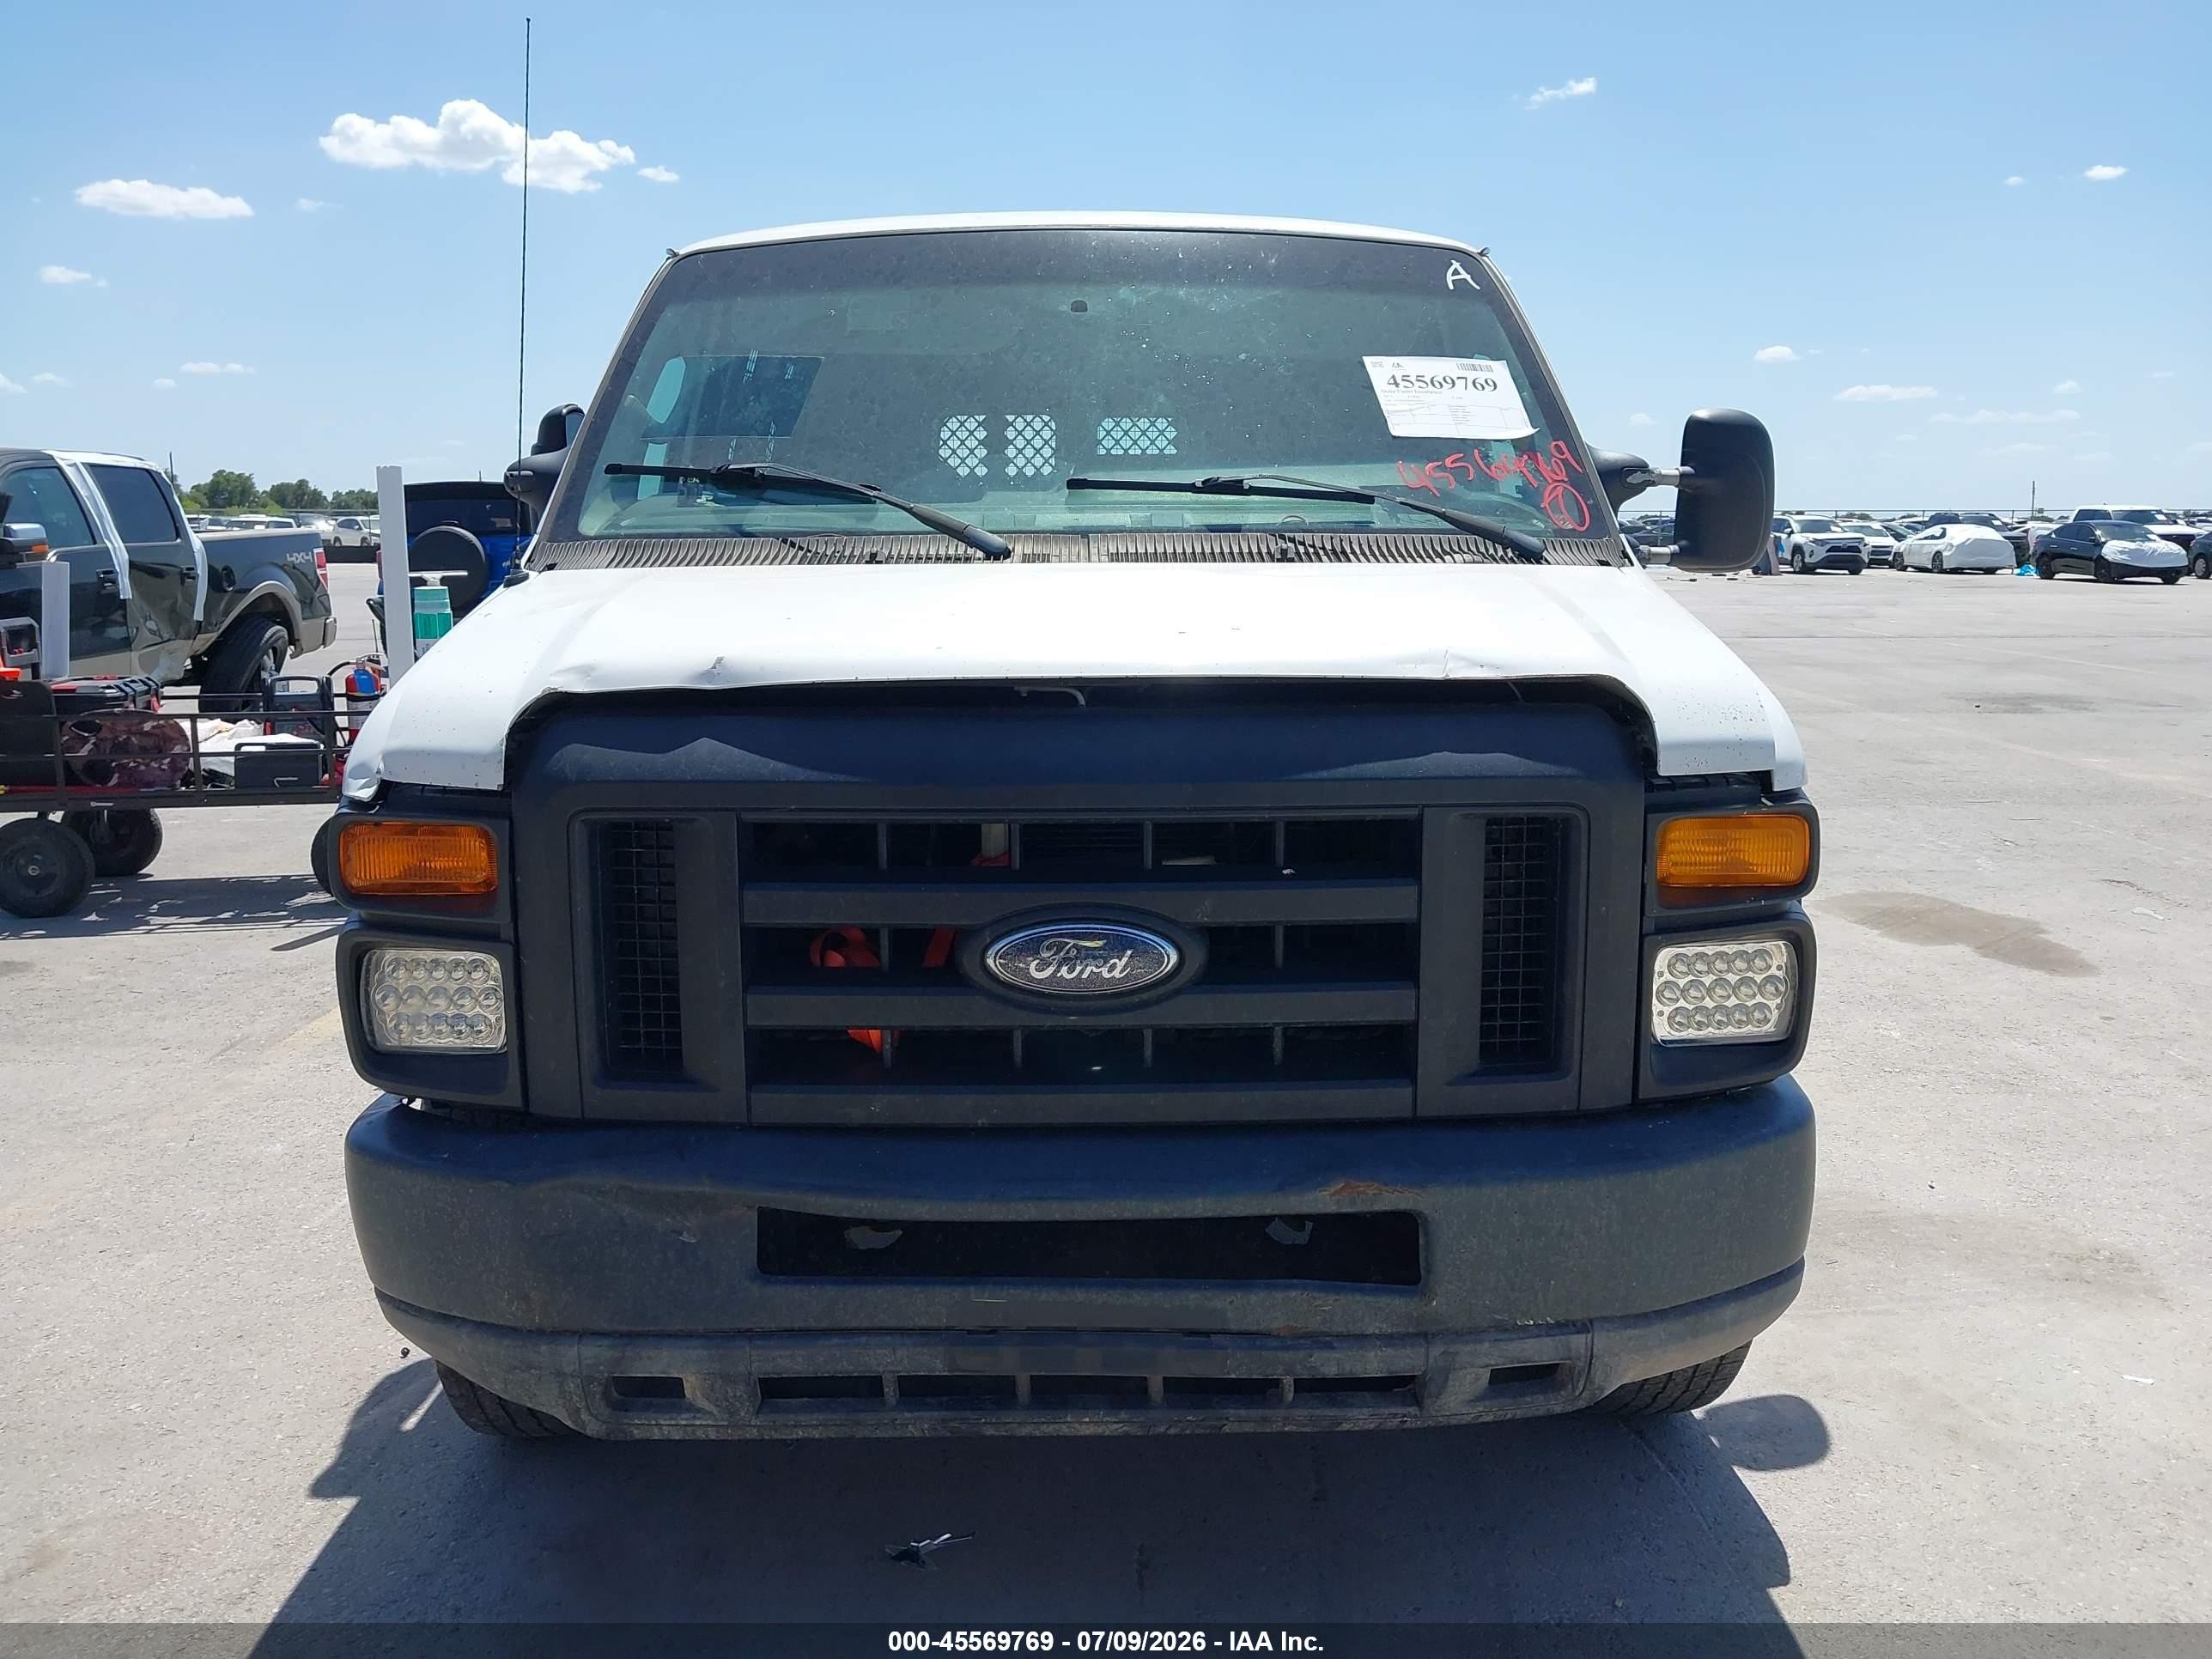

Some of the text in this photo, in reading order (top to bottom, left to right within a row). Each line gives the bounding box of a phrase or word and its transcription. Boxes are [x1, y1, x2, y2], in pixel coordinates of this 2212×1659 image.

[1446, 260, 1480, 289] A
[1387, 374, 1498, 392] 45569769
[1030, 938, 1133, 979] Ford
